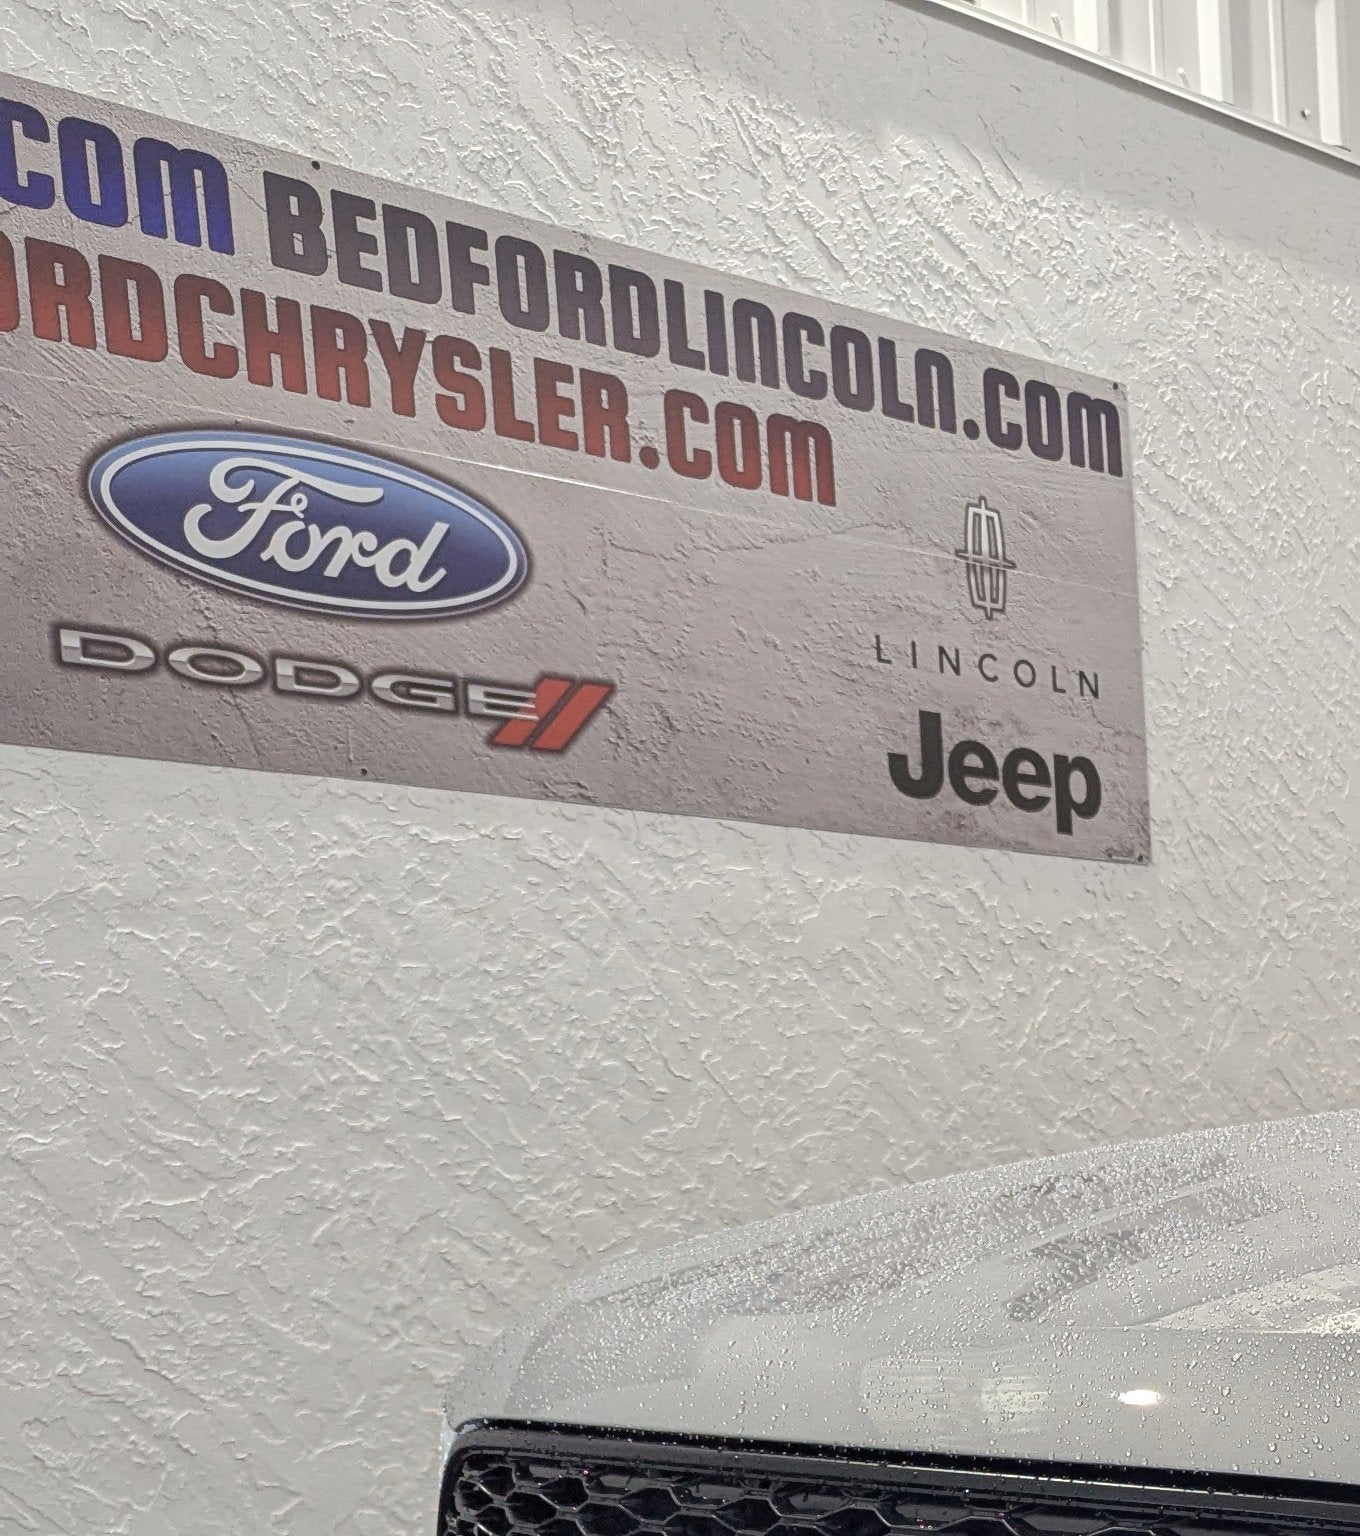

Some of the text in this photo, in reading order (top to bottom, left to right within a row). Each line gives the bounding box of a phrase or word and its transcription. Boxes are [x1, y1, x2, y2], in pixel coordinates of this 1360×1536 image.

[263, 170, 1123, 477] BEDFORDLINCOLN.COM
[183, 457, 449, 593] Ford
[58, 627, 539, 722] DODGE
[875, 634, 1099, 699] LINCOLN
[887, 710, 1101, 836] Jeep
